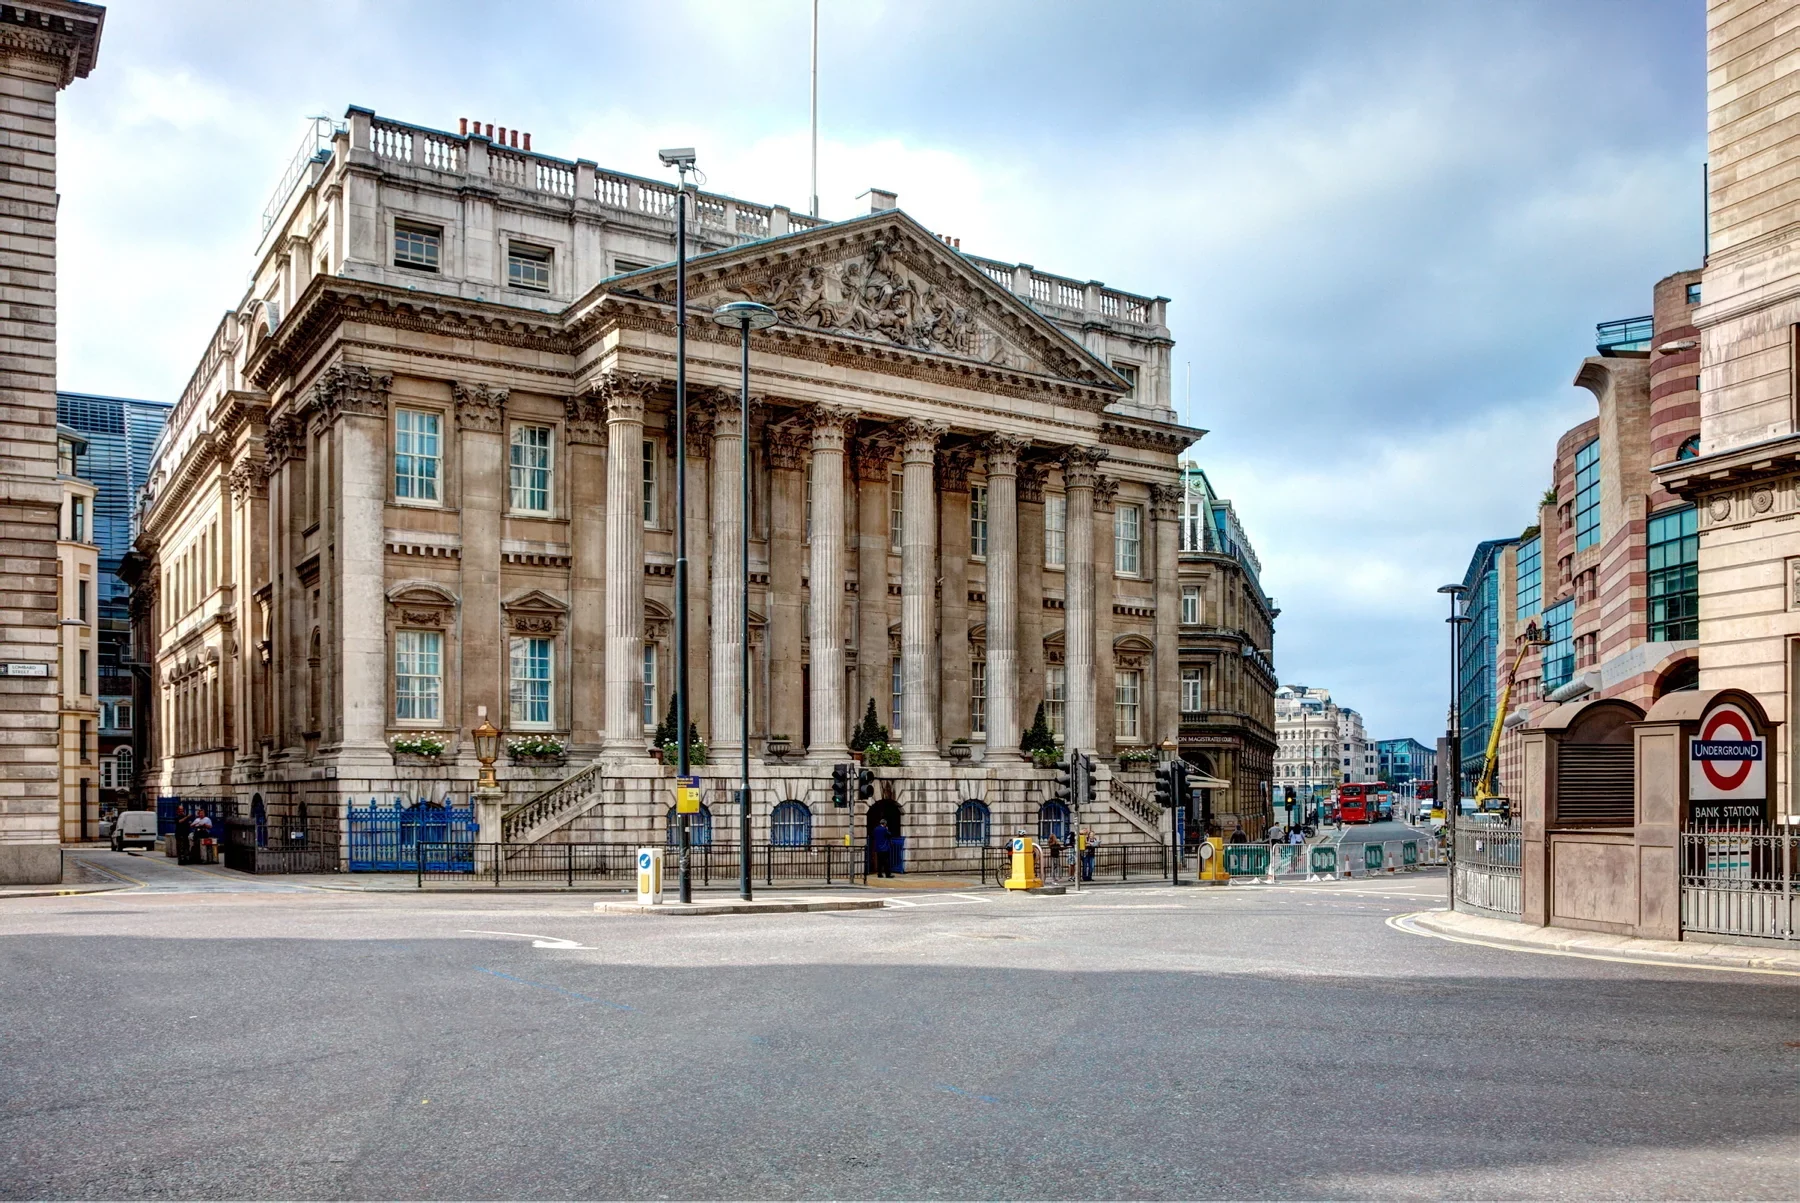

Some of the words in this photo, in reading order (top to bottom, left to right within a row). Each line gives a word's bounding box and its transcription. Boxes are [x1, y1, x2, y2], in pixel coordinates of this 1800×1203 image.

[1694, 744, 1759, 757] UNDERGROUND
[1695, 807, 1720, 818] BANK
[1723, 806, 1759, 817] STATION
